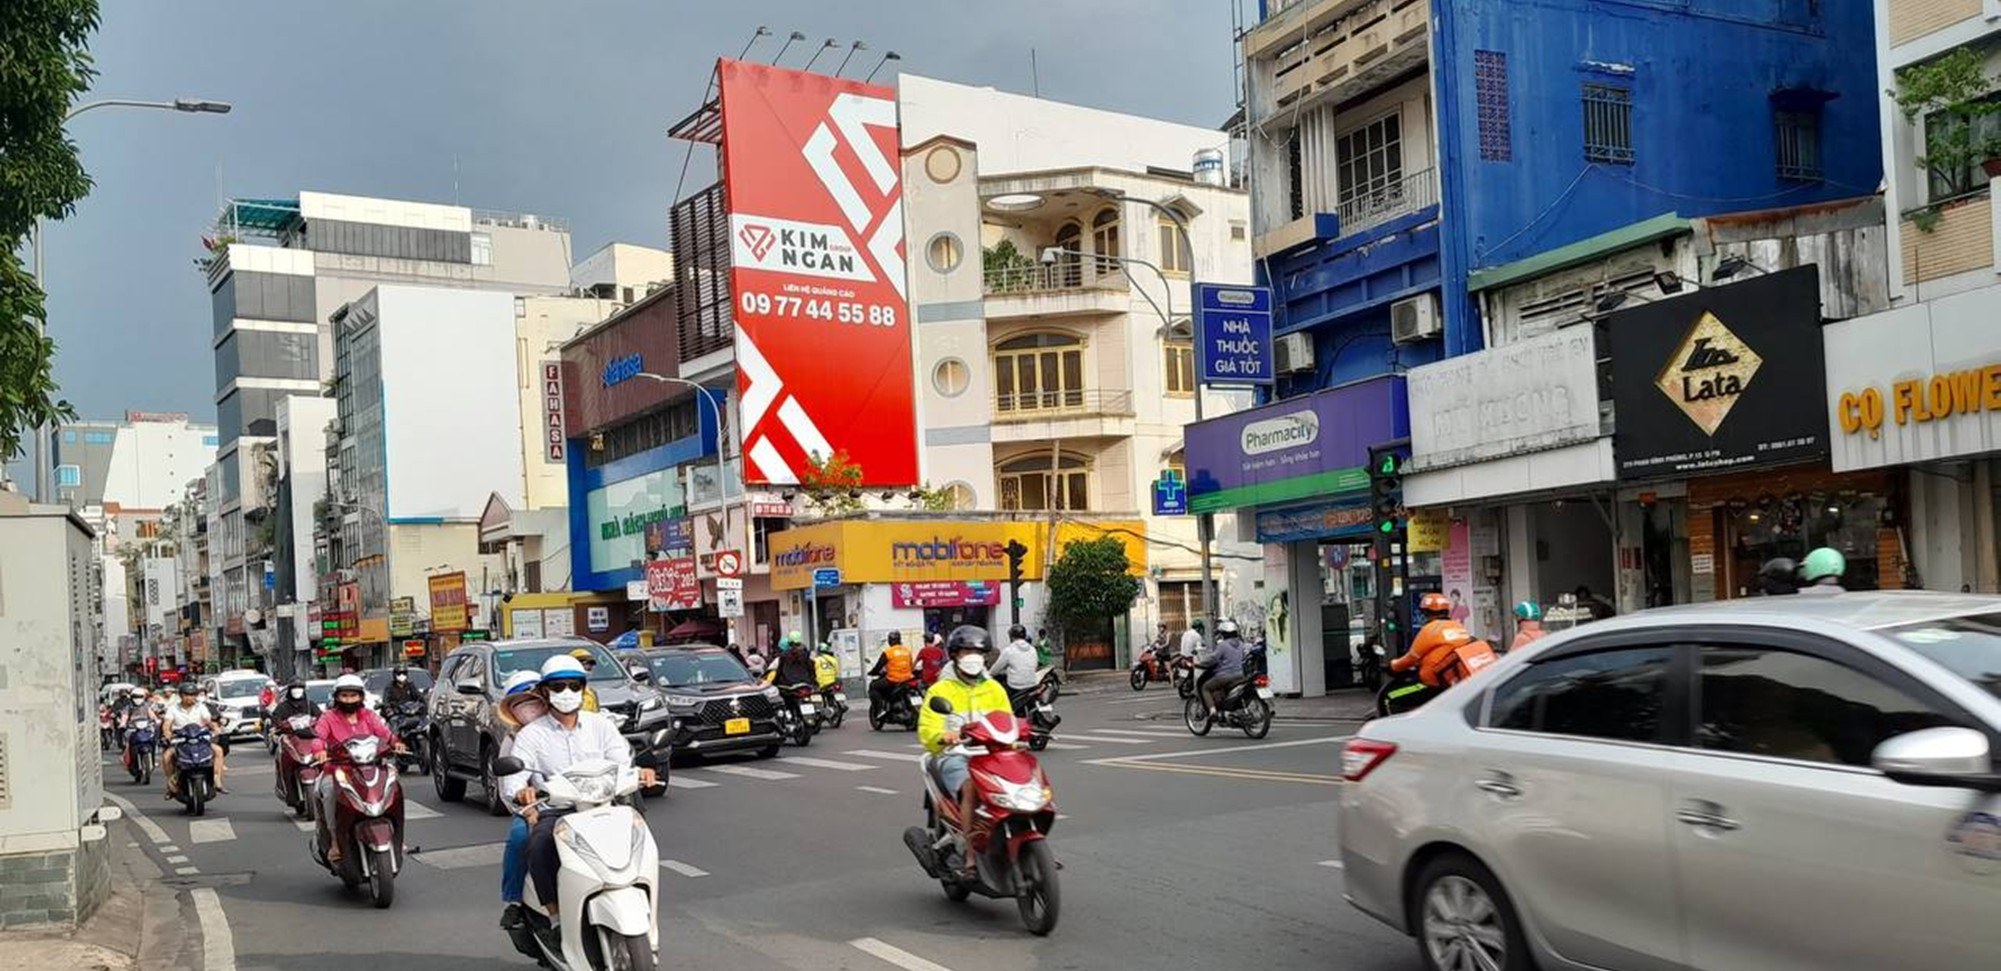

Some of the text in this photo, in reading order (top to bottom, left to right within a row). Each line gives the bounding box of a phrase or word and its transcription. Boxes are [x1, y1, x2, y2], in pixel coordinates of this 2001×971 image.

[781, 228, 828, 251] KIM
[782, 249, 853, 273] NGAN
[741, 292, 896, 326] 09 77 44 55 88
[1223, 318, 1251, 334] NHÀ
[1216, 335, 1259, 354] THUỐC
[1215, 355, 1262, 374] GIÁ TỐT
[1683, 373, 1743, 403] Lata
[546, 365, 562, 459] FAHASA
[1838, 386, 1885, 440] CỌ
[1246, 424, 1312, 449] Pharmacity
[774, 541, 836, 567] mobifone
[892, 536, 1004, 560] mobifone
